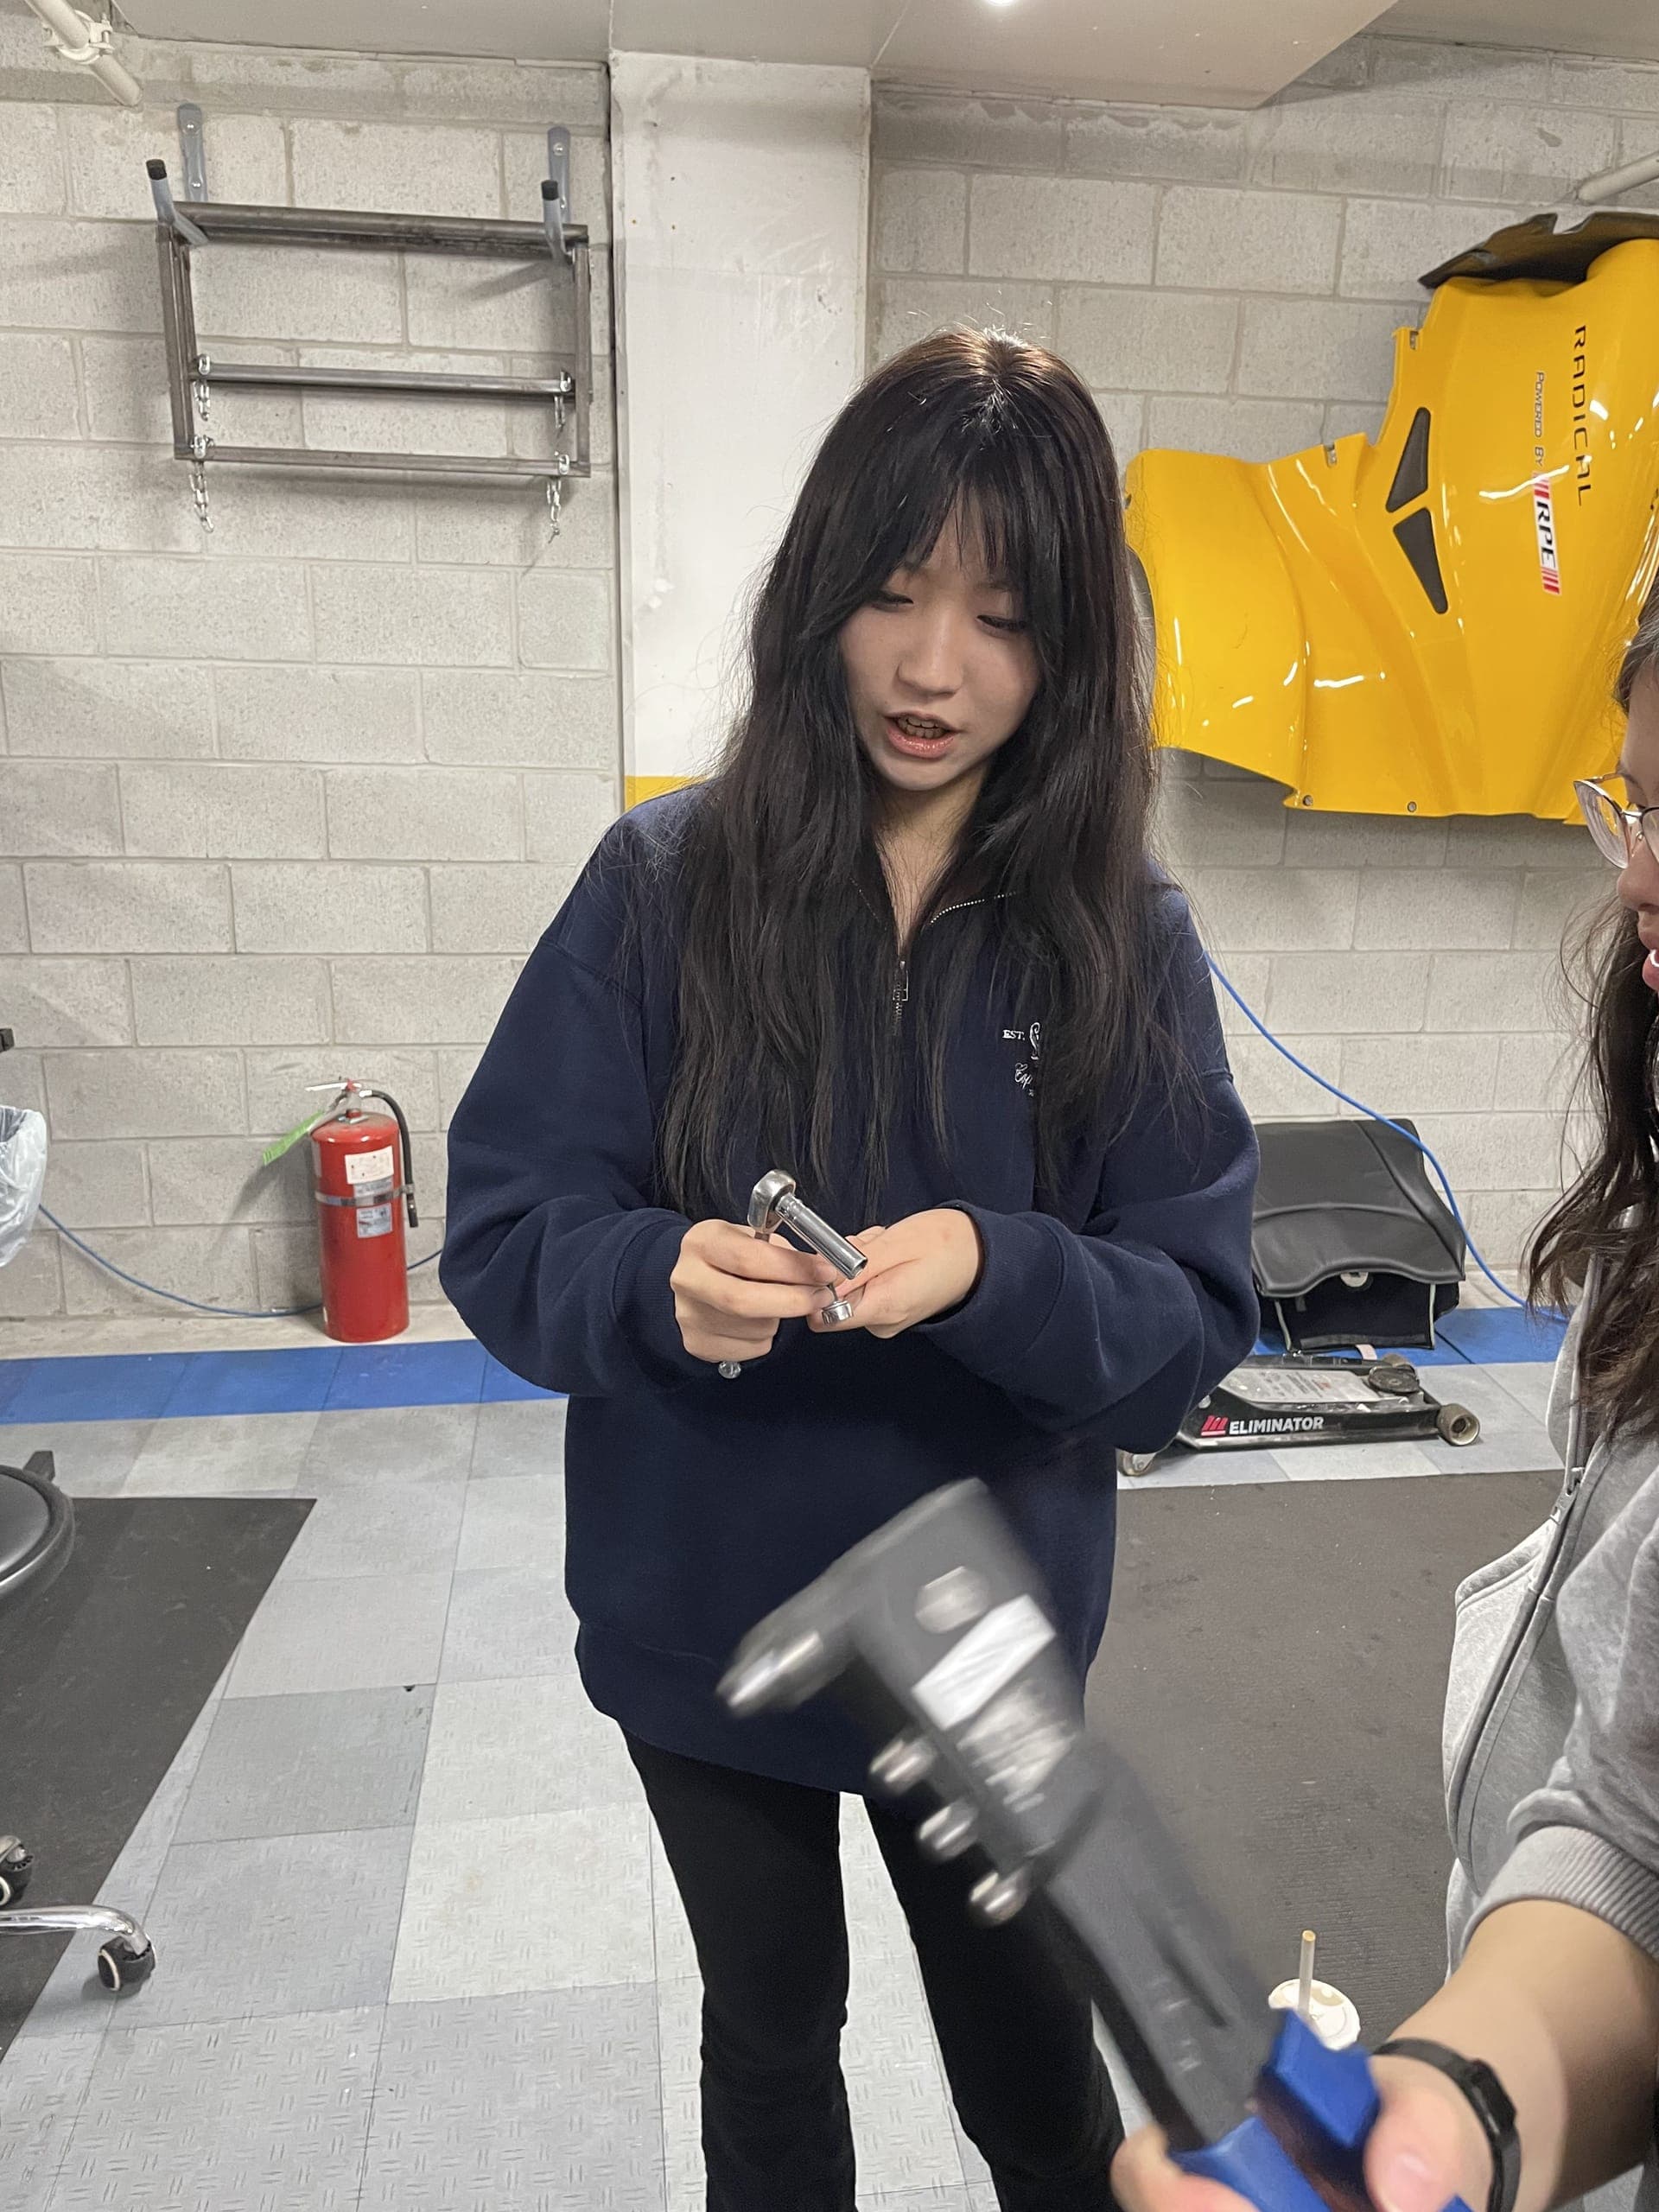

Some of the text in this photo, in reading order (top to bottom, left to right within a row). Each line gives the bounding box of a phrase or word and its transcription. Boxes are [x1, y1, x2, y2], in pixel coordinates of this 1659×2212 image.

[1572, 325, 1592, 506] RADICAL
[1536, 501, 1556, 569] RPE
[1002, 1029, 1026, 1041] EST.
[1229, 1416, 1325, 1435] ELIMINATOR
